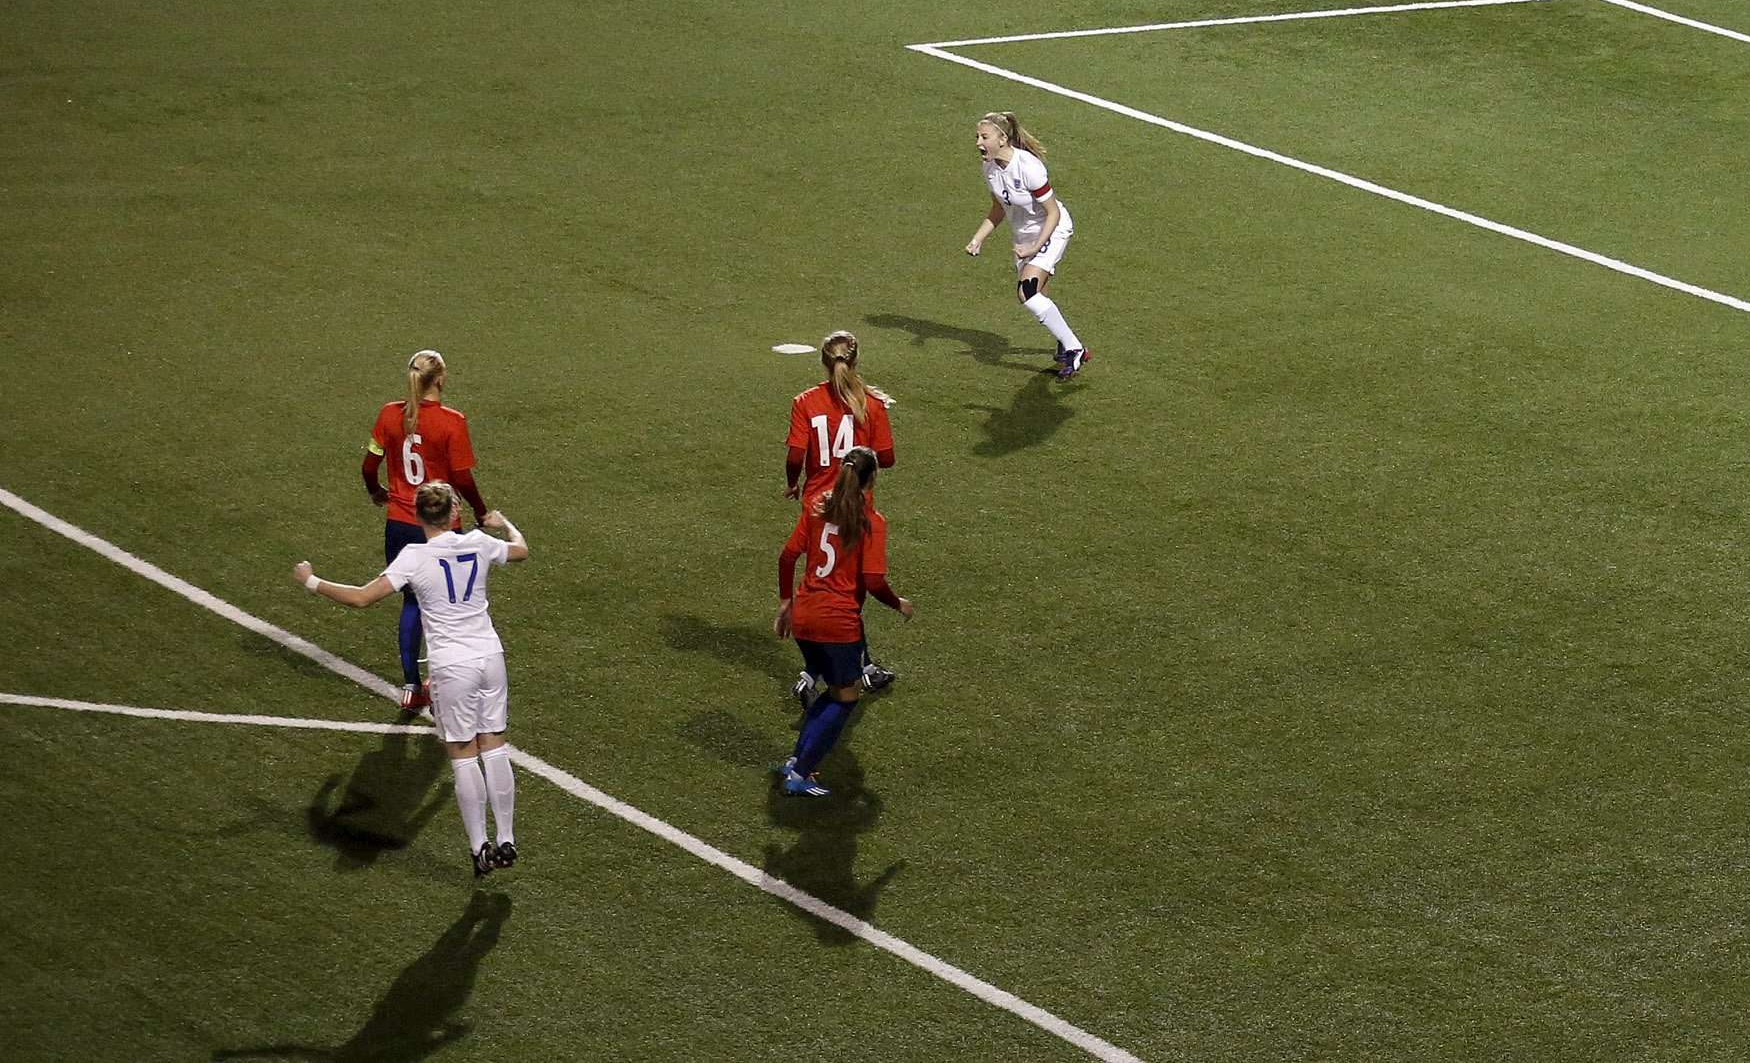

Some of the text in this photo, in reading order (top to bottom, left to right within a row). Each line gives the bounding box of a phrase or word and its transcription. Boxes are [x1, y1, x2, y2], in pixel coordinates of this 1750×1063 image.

[402, 433, 426, 486] 6
[811, 413, 855, 467] 14
[815, 522, 839, 579] 5
[438, 552, 479, 605] 17
